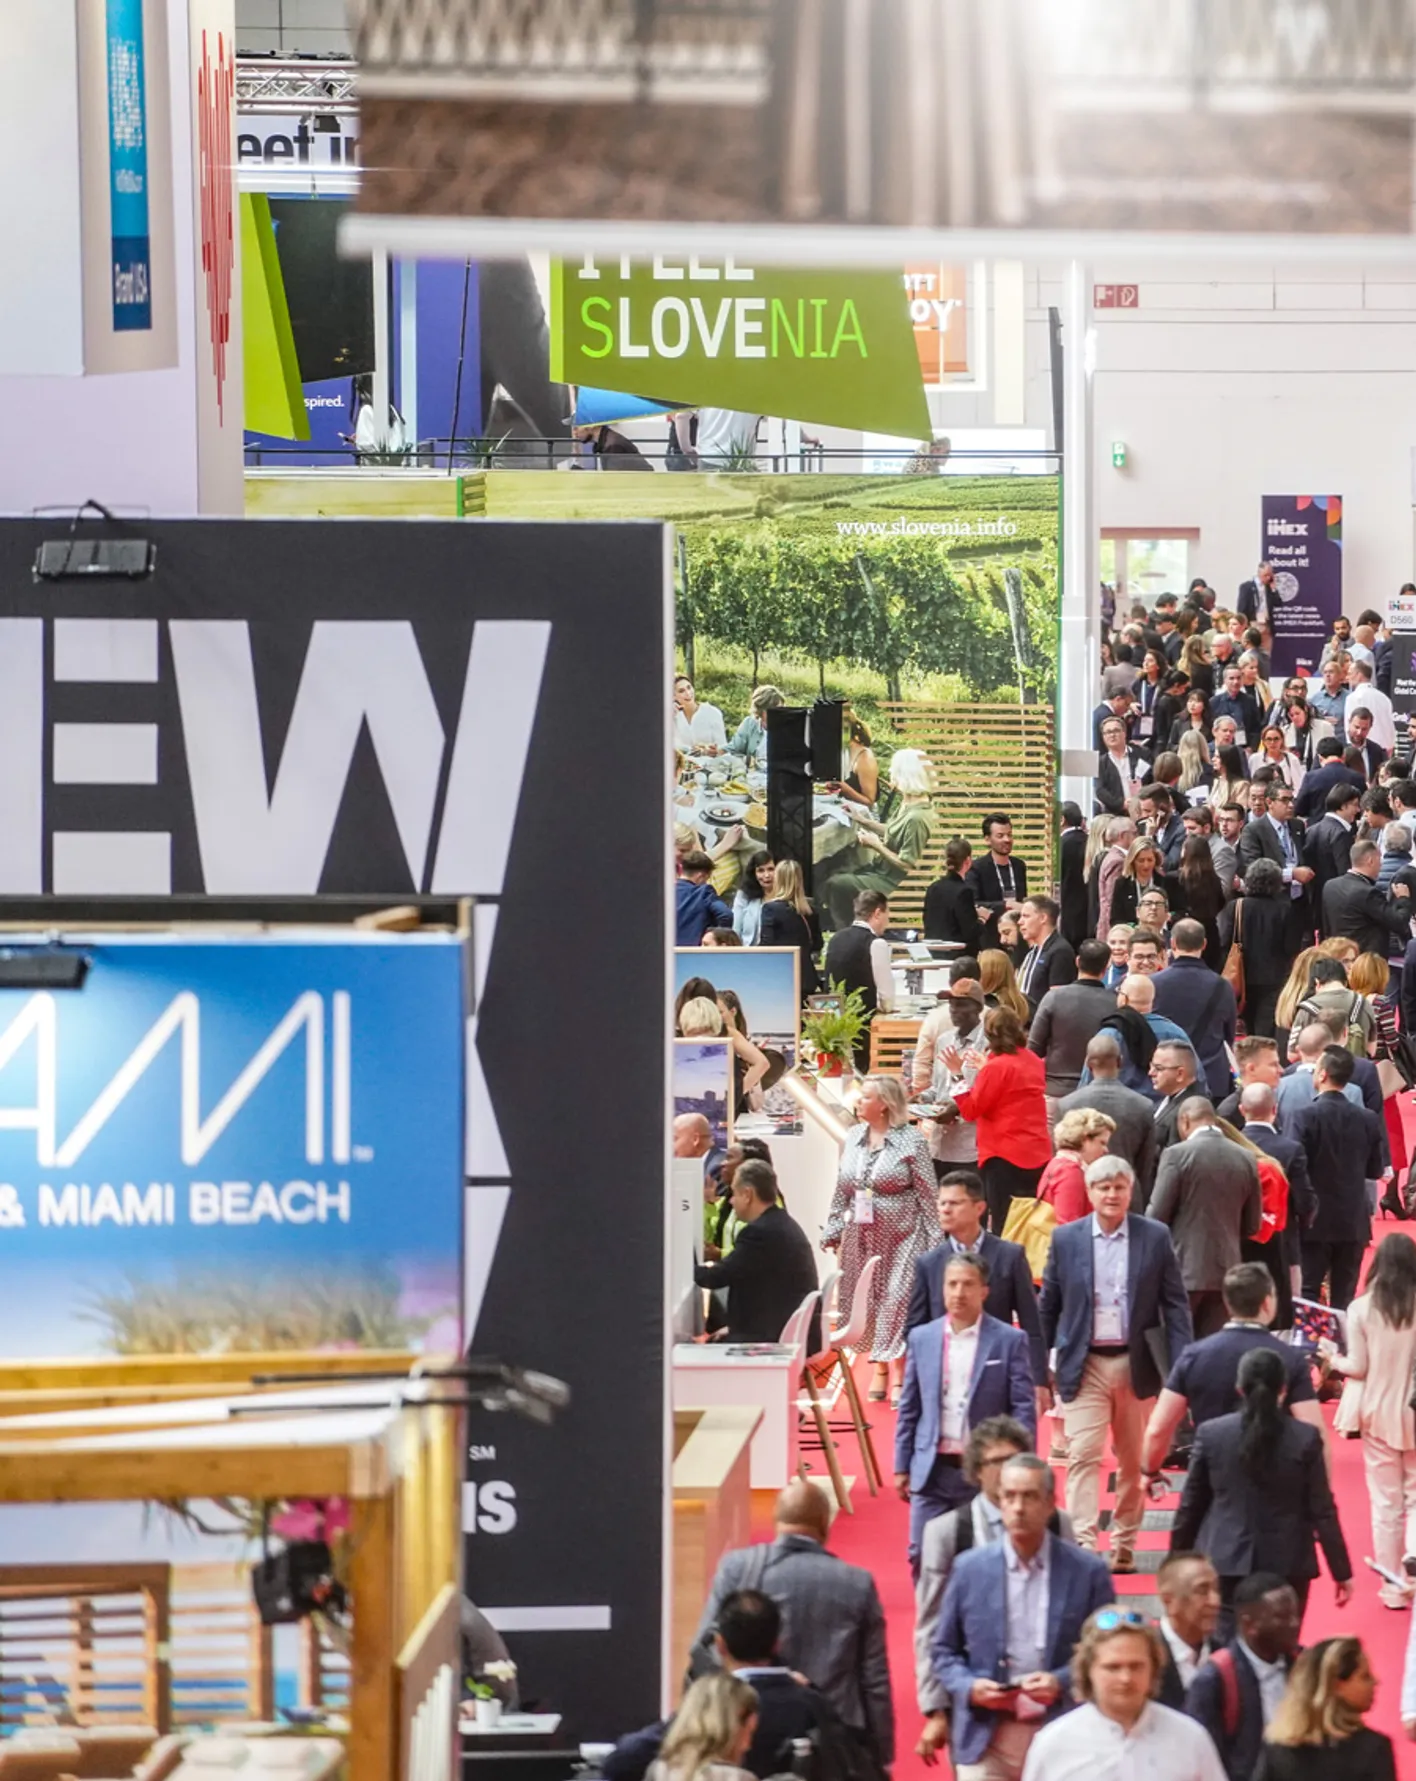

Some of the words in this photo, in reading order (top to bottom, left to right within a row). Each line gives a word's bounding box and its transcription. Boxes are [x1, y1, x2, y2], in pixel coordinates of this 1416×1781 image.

[580, 296, 868, 359] SLOVENIA
[303, 394, 345, 411] spired.
[836, 516, 1017, 535] www.slovenia.info
[1268, 545, 1293, 555] Read
[1294, 545, 1307, 555] all
[1390, 615, 1414, 625] D560
[0, 1183, 26, 1228] &
[38, 1182, 175, 1227] MIAMI
[189, 1180, 350, 1225] BEACH
[469, 1445, 496, 1461] SM
